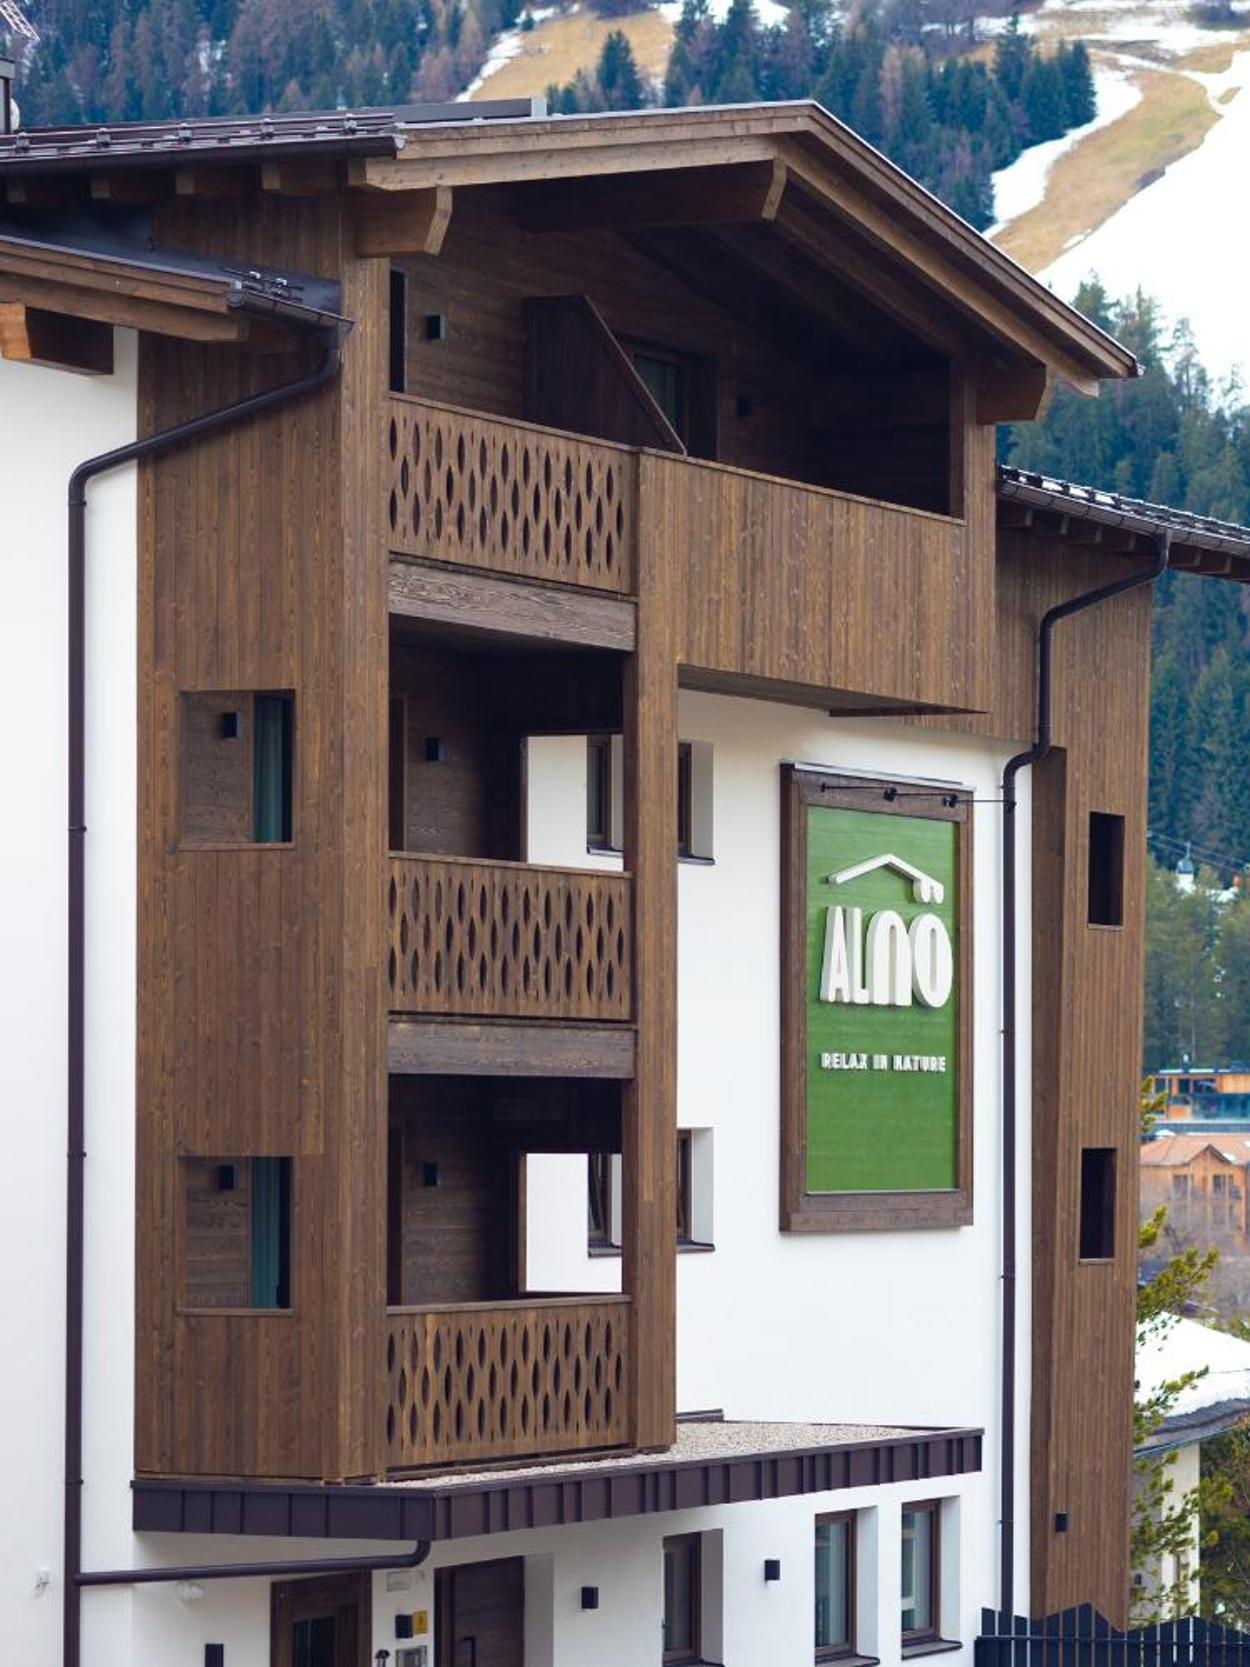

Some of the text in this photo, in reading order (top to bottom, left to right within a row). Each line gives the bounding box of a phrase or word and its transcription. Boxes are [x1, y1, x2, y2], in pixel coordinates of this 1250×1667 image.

[821, 1053, 946, 1072] RELAX IN NATURE
